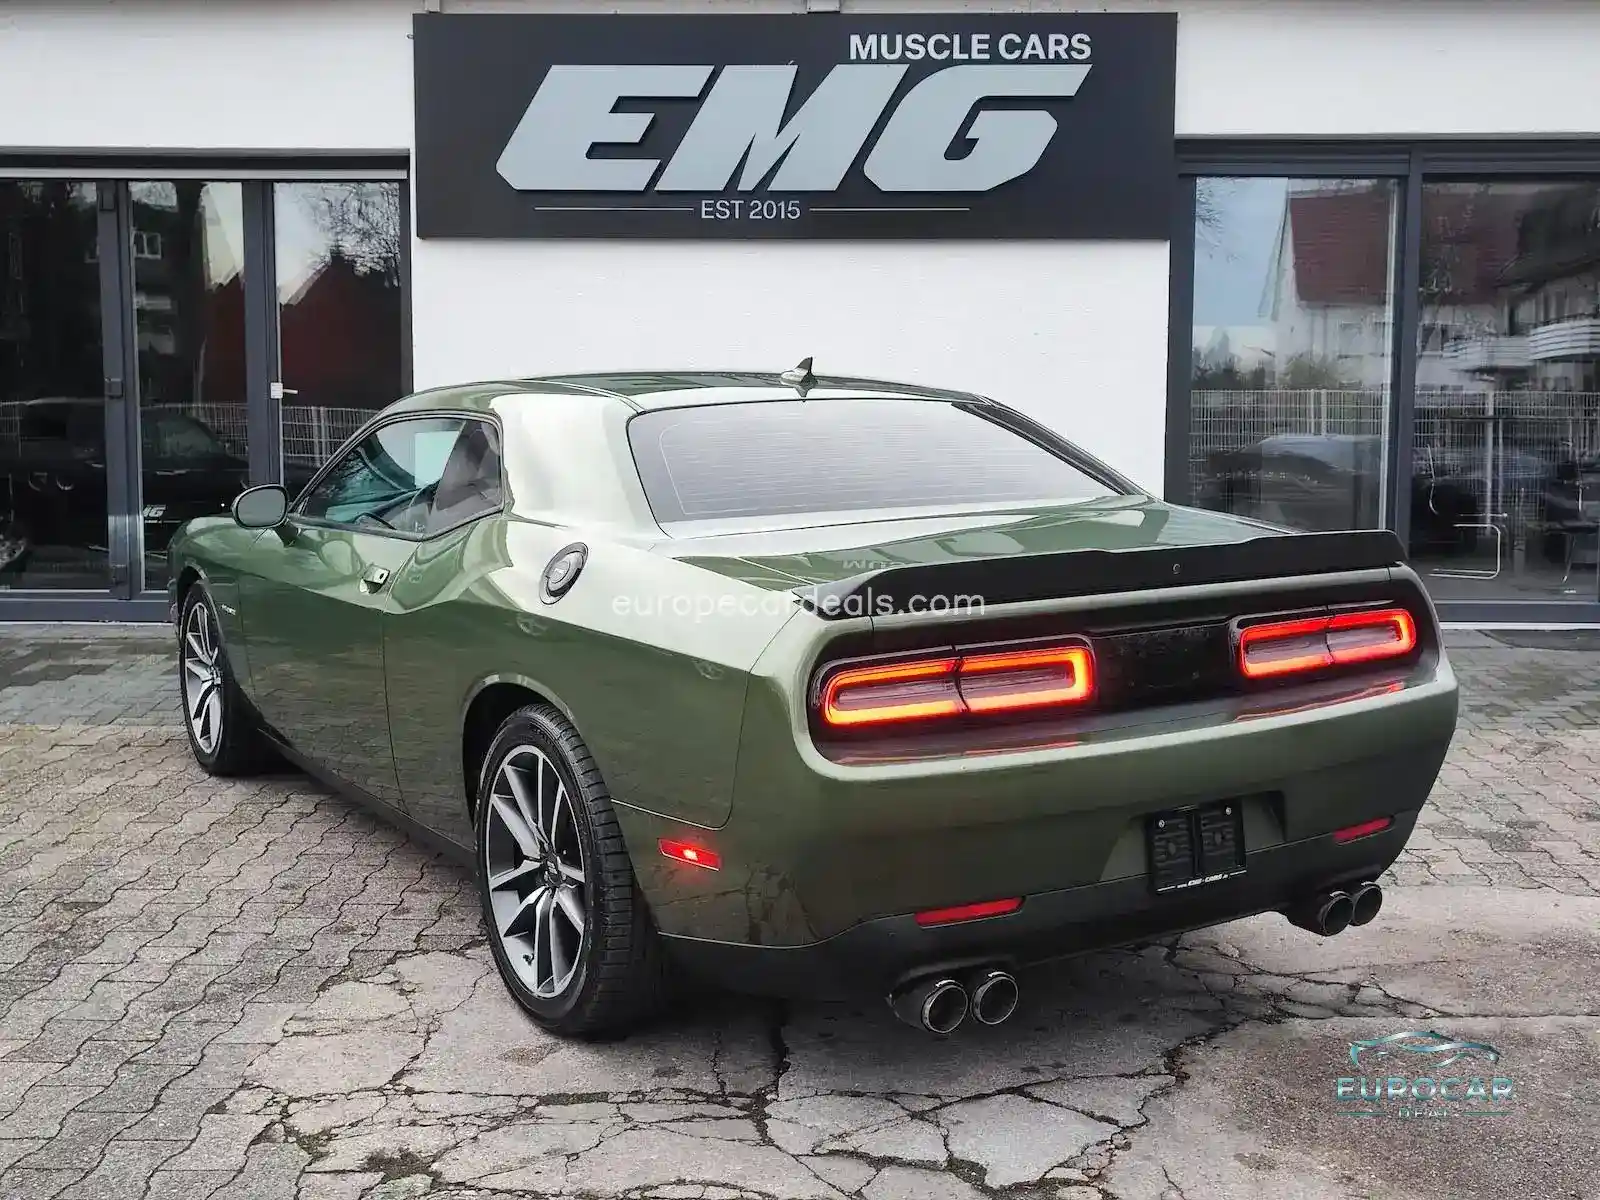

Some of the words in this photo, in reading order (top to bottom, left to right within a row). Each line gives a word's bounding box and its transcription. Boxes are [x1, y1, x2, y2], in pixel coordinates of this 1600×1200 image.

[850, 33, 991, 60] MUSCLE
[998, 33, 1092, 60] CARS
[496, 64, 1093, 192] EMG
[701, 200, 744, 219] EST
[749, 200, 800, 219] 2015
